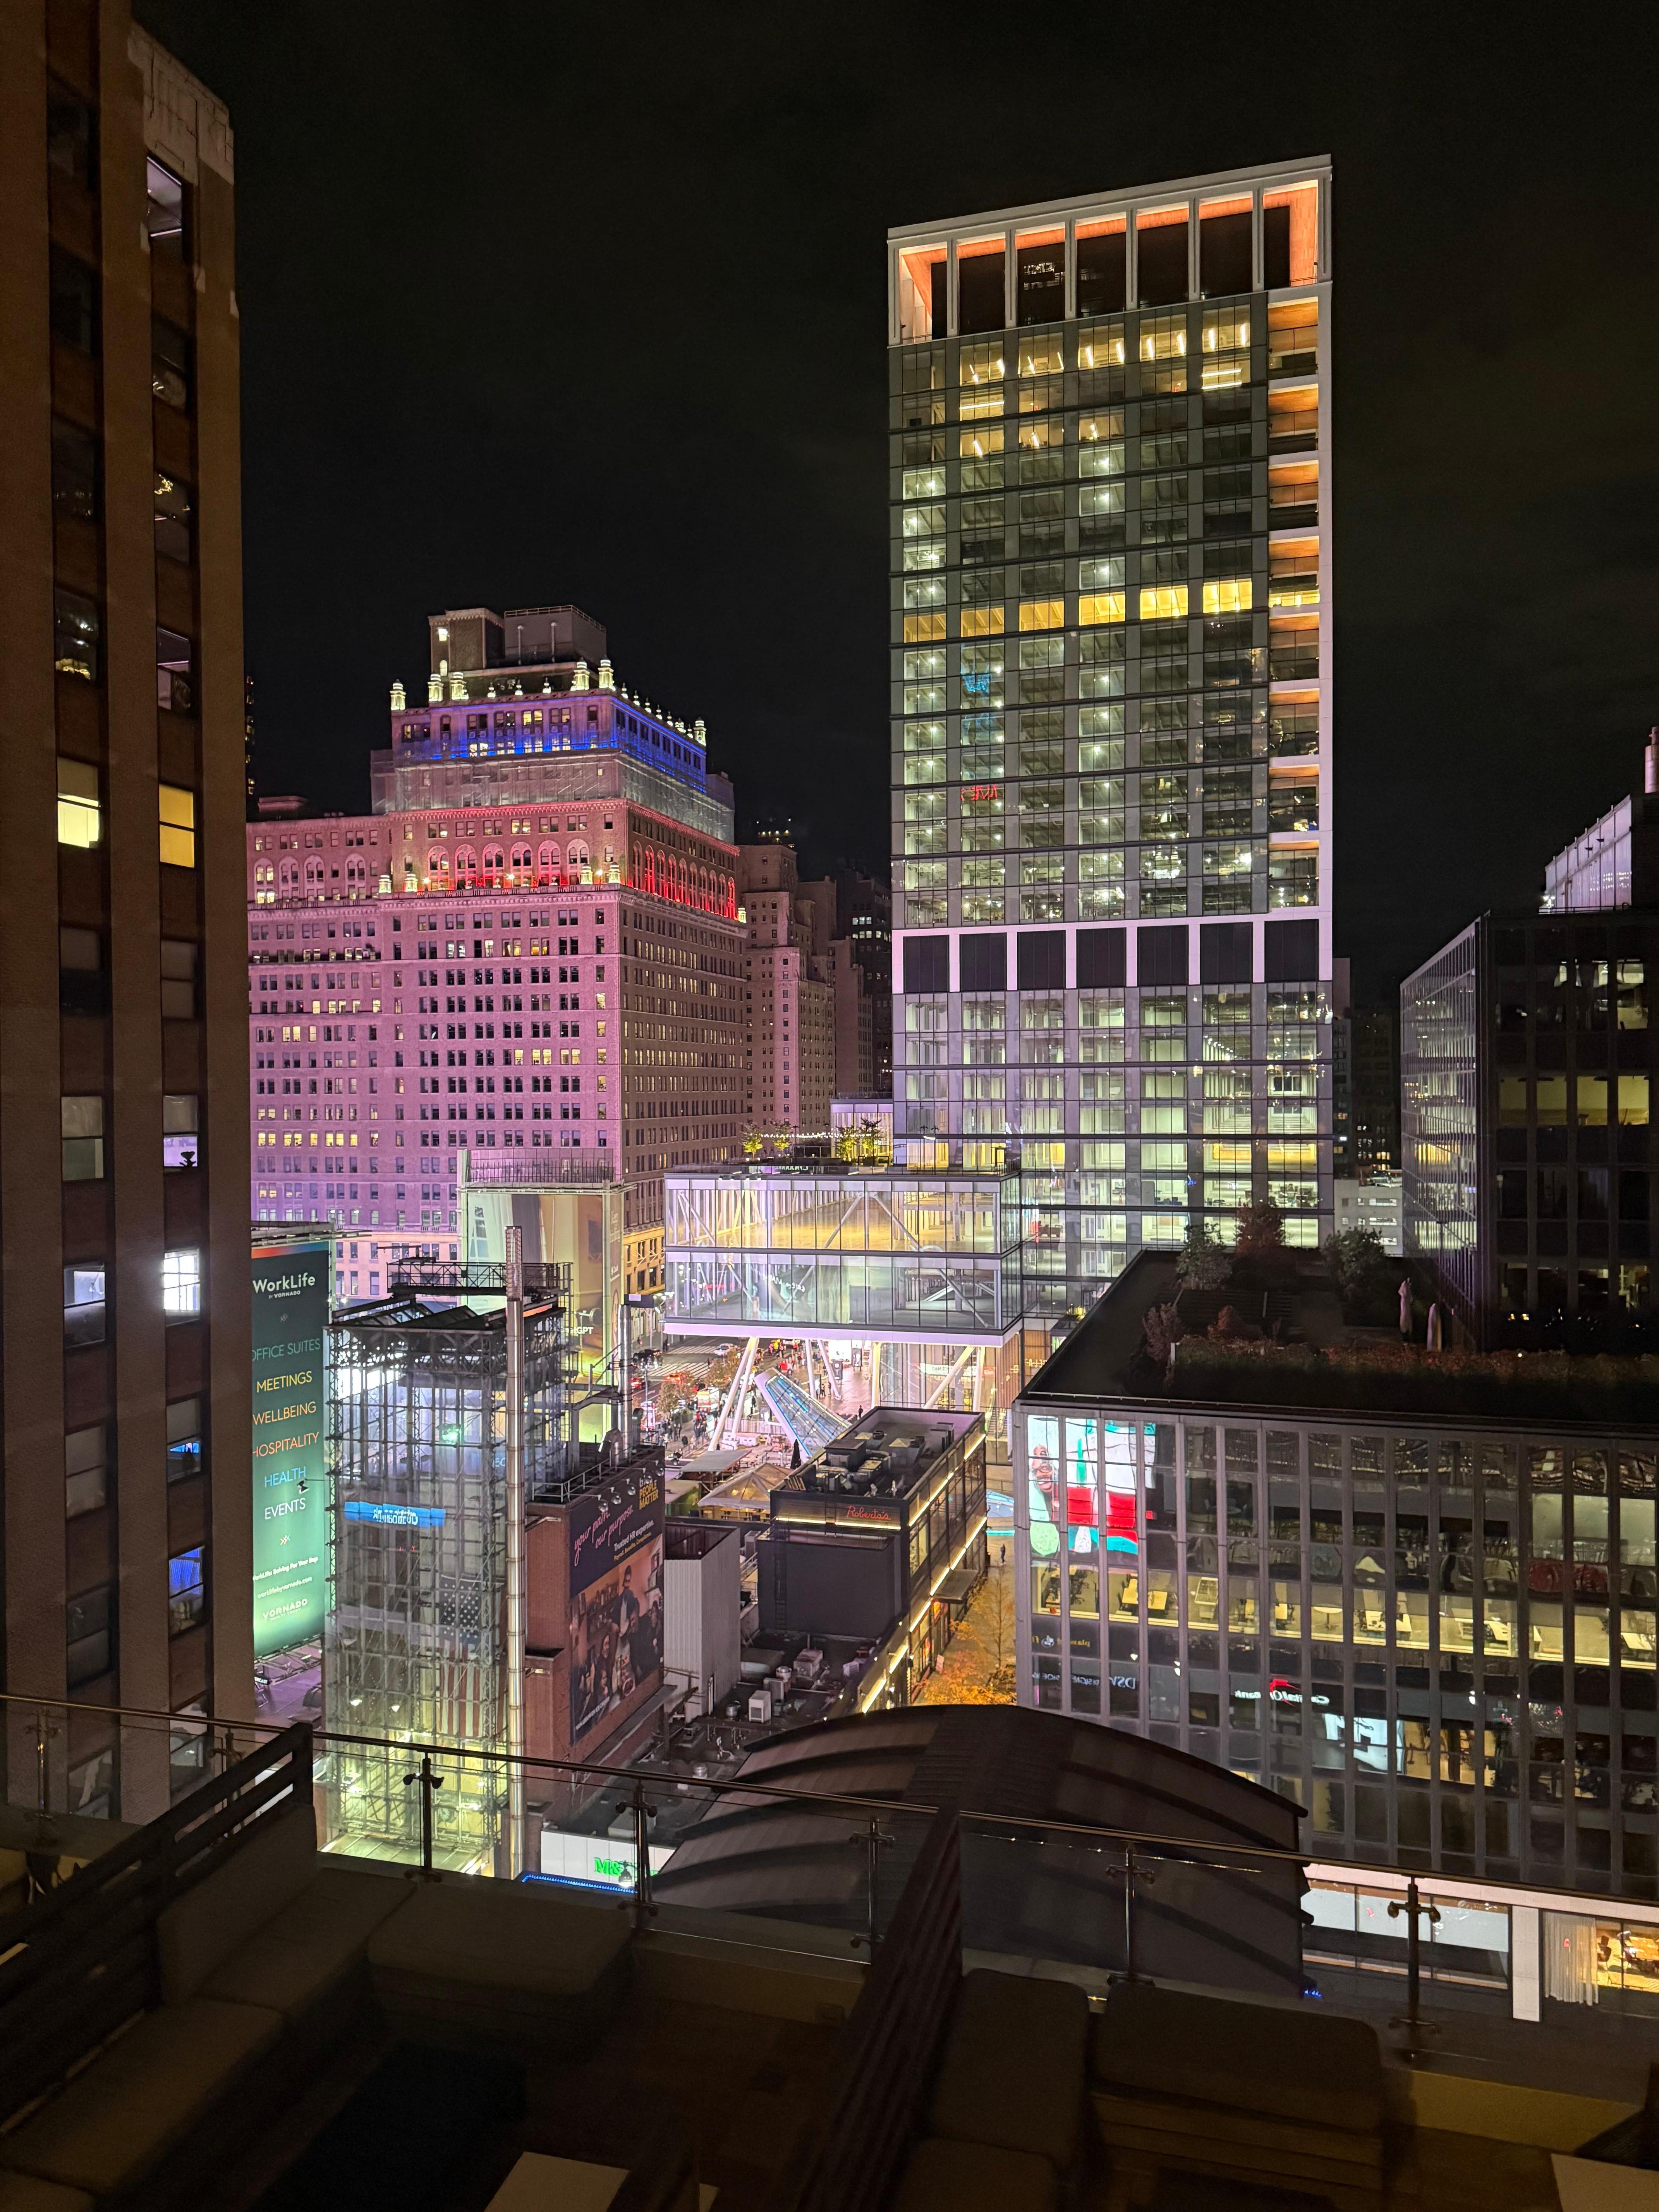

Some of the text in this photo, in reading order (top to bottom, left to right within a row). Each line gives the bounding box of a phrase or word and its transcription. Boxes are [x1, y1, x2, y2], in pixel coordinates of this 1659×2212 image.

[252, 1273, 316, 1293] WorkLife
[274, 1290, 301, 1298] VORNADO
[287, 1338, 321, 1355] SUITES
[257, 1371, 312, 1393] MEETINGS
[252, 1401, 316, 1425] WELLBEING
[252, 1432, 319, 1457] HOSPITALITY
[264, 1466, 306, 1487] HEALTH
[264, 1498, 306, 1520] EVENTS
[639, 1489, 658, 1510] MATTER
[845, 1505, 891, 1520] Roberta's
[574, 1526, 591, 1567] your
[595, 1530, 607, 1549] our
[614, 1534, 629, 1551] Trusted
[263, 1598, 308, 1620] VORNADO
